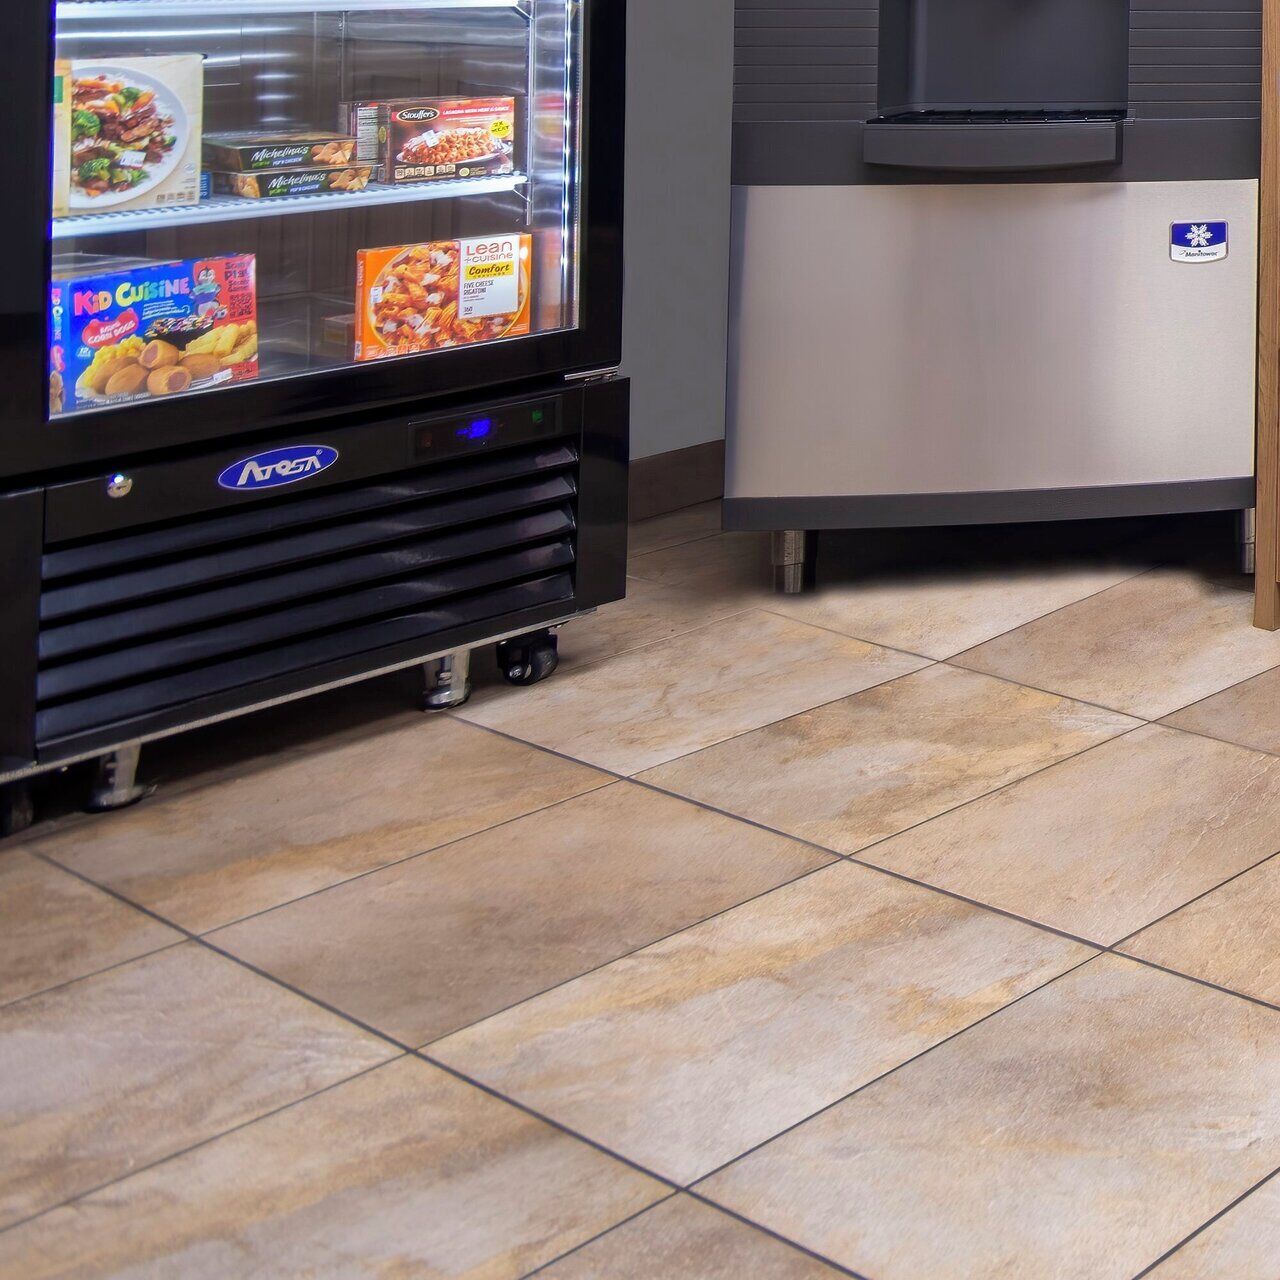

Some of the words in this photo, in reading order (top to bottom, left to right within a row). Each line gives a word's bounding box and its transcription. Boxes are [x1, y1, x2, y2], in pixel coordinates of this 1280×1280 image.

[400, 109, 436, 120] Stouffer's
[250, 145, 309, 163] Michelina's
[268, 172, 326, 189] Michelina's
[466, 240, 513, 255] Lean
[1185, 249, 1218, 258] Manitowoc
[469, 264, 510, 276] Comfort
[463, 282, 475, 290] FIVE
